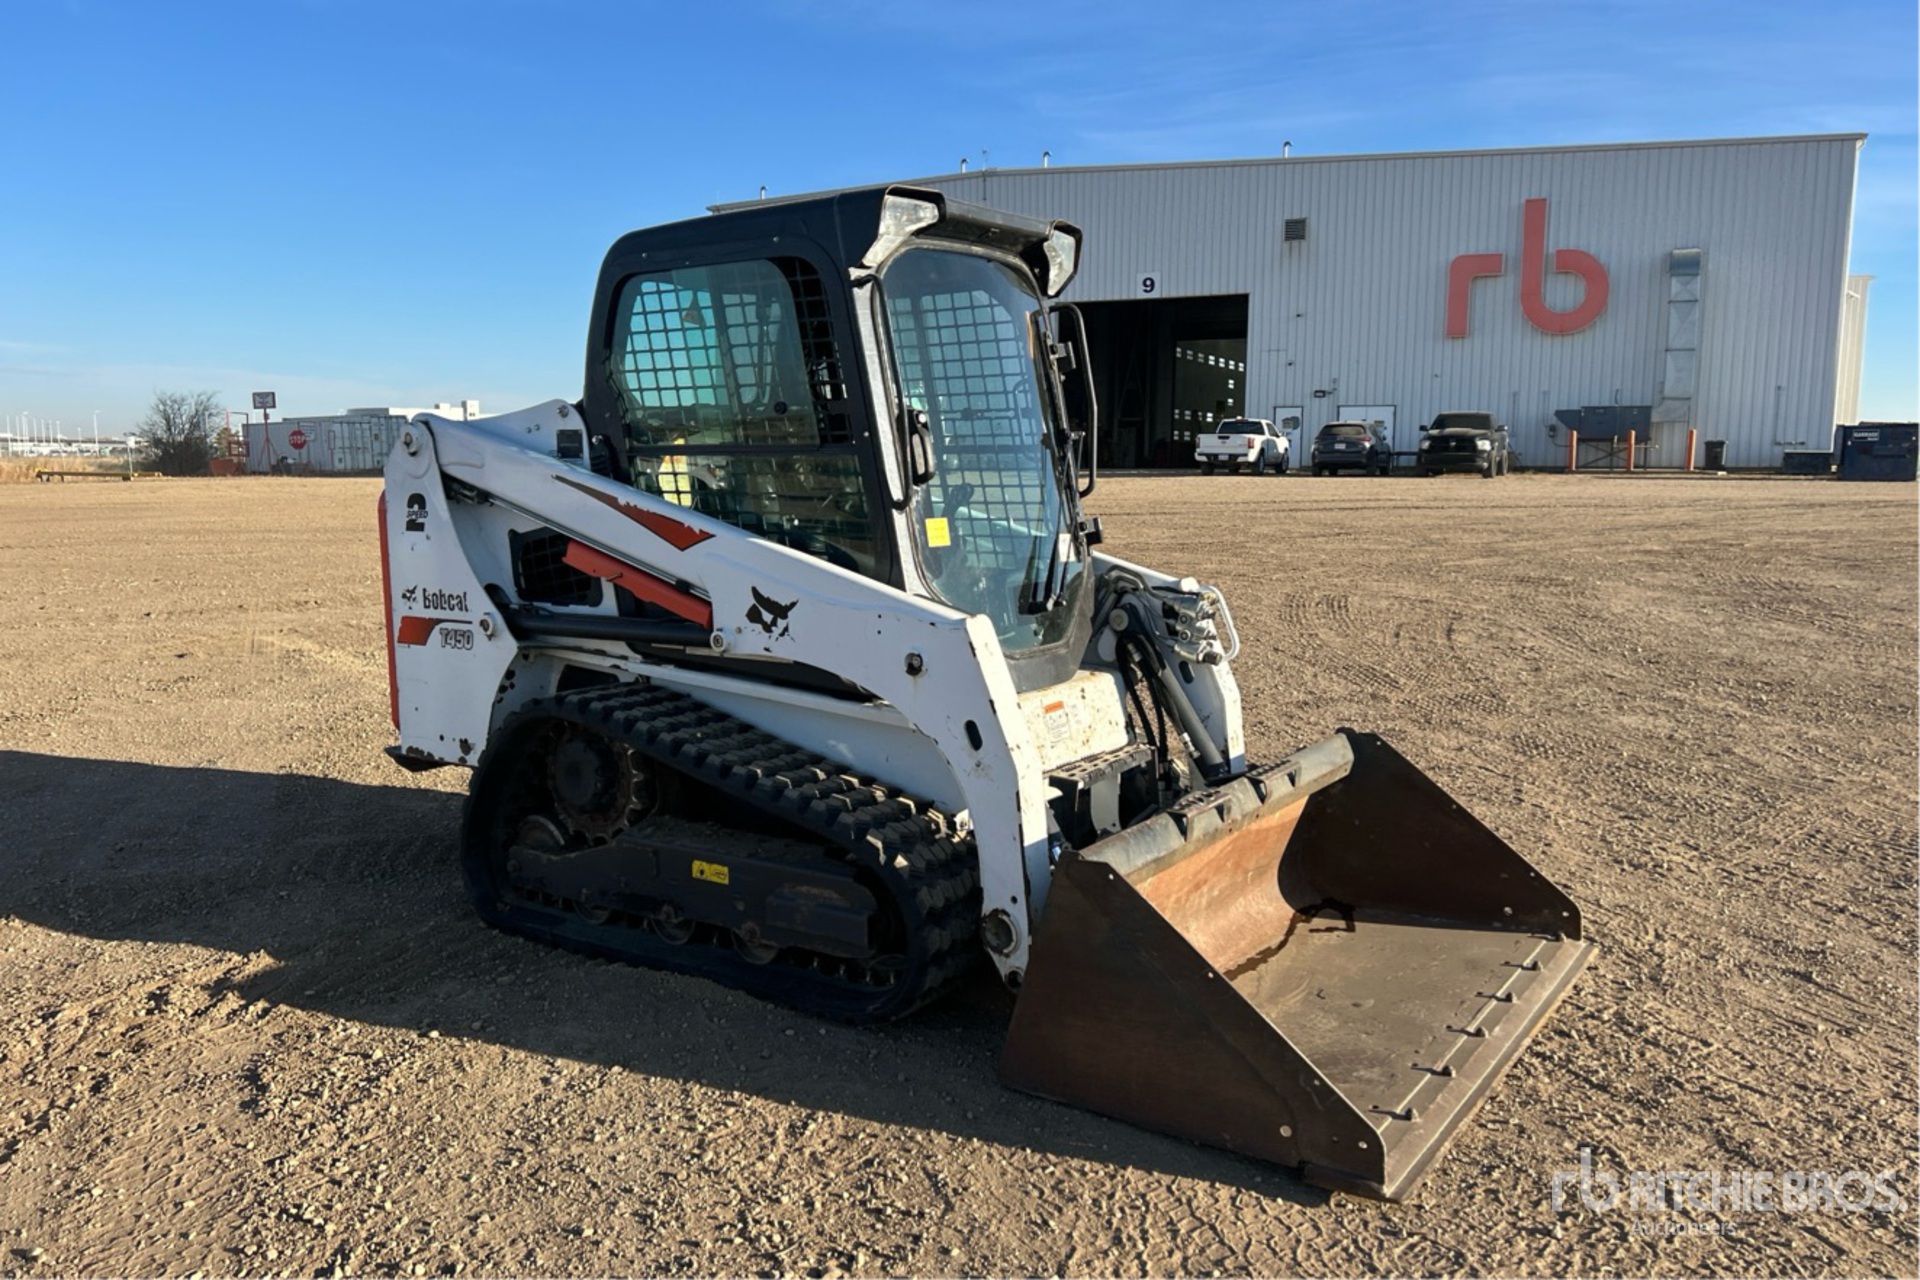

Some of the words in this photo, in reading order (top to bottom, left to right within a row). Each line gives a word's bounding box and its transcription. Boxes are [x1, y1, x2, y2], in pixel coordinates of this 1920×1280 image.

[1446, 198, 1609, 338] rb
[1142, 277, 1155, 293] 9
[289, 434, 307, 444] STOP
[405, 493, 427, 532] 2
[406, 510, 429, 519] SPEED
[439, 627, 474, 651] T450
